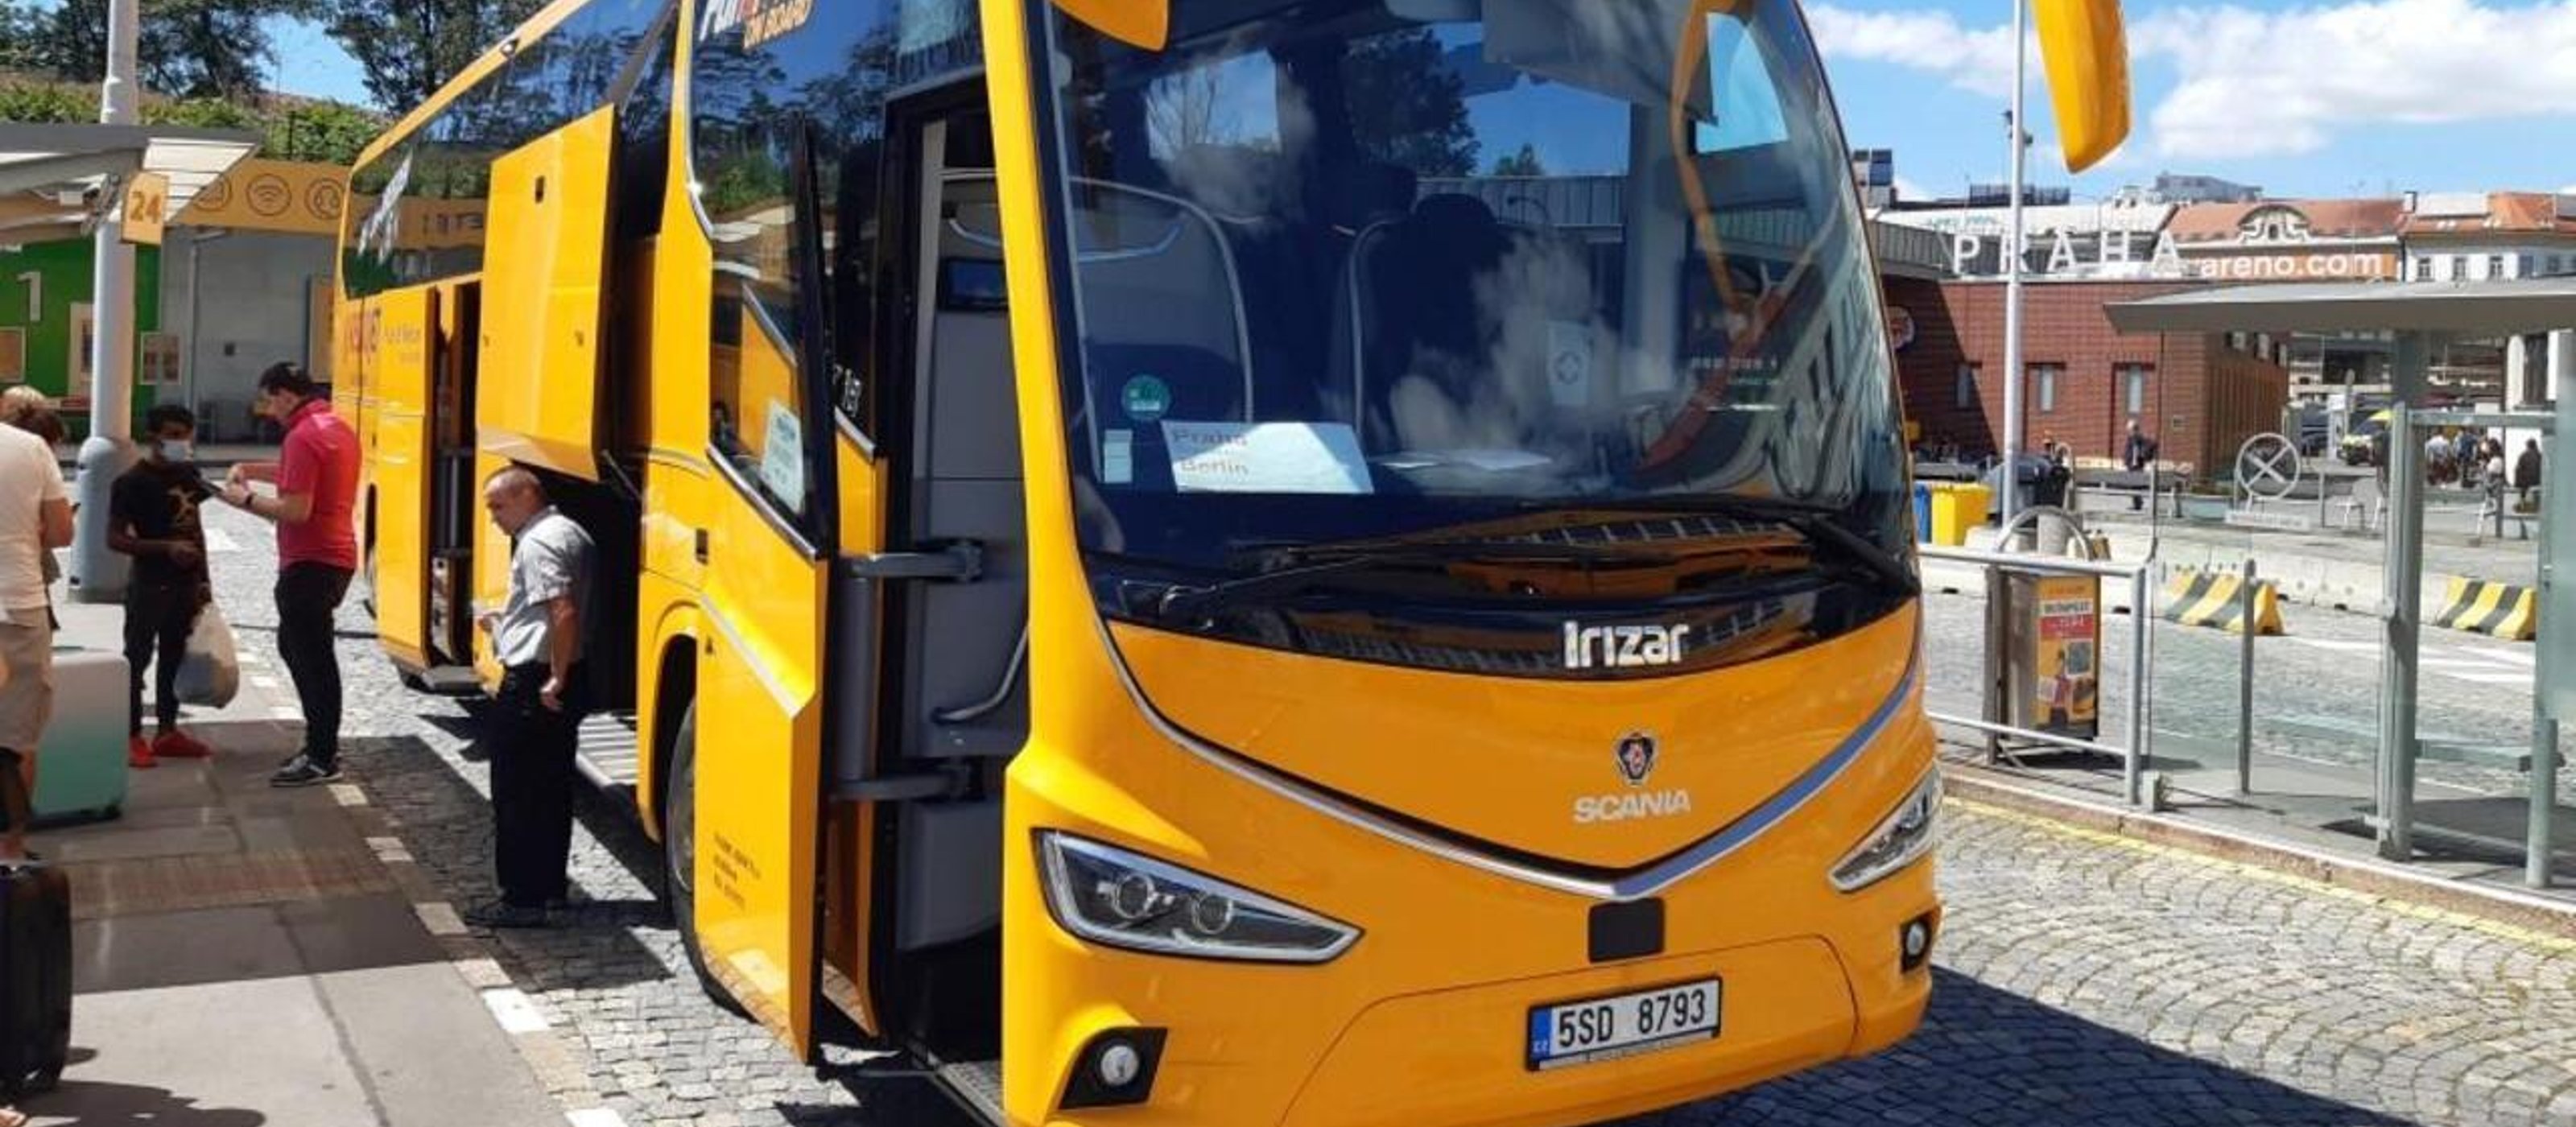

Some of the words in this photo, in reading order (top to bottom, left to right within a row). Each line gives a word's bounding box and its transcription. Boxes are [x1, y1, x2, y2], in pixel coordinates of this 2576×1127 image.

[129, 191, 162, 223] 24
[1952, 228, 2181, 275] PRAHA
[16, 270, 41, 322] 1
[1180, 458, 1249, 477] Berlin
[1574, 789, 1691, 823] SCANIA
[1558, 1005, 1614, 1047] 5SD
[1637, 988, 1707, 1034] 8793
